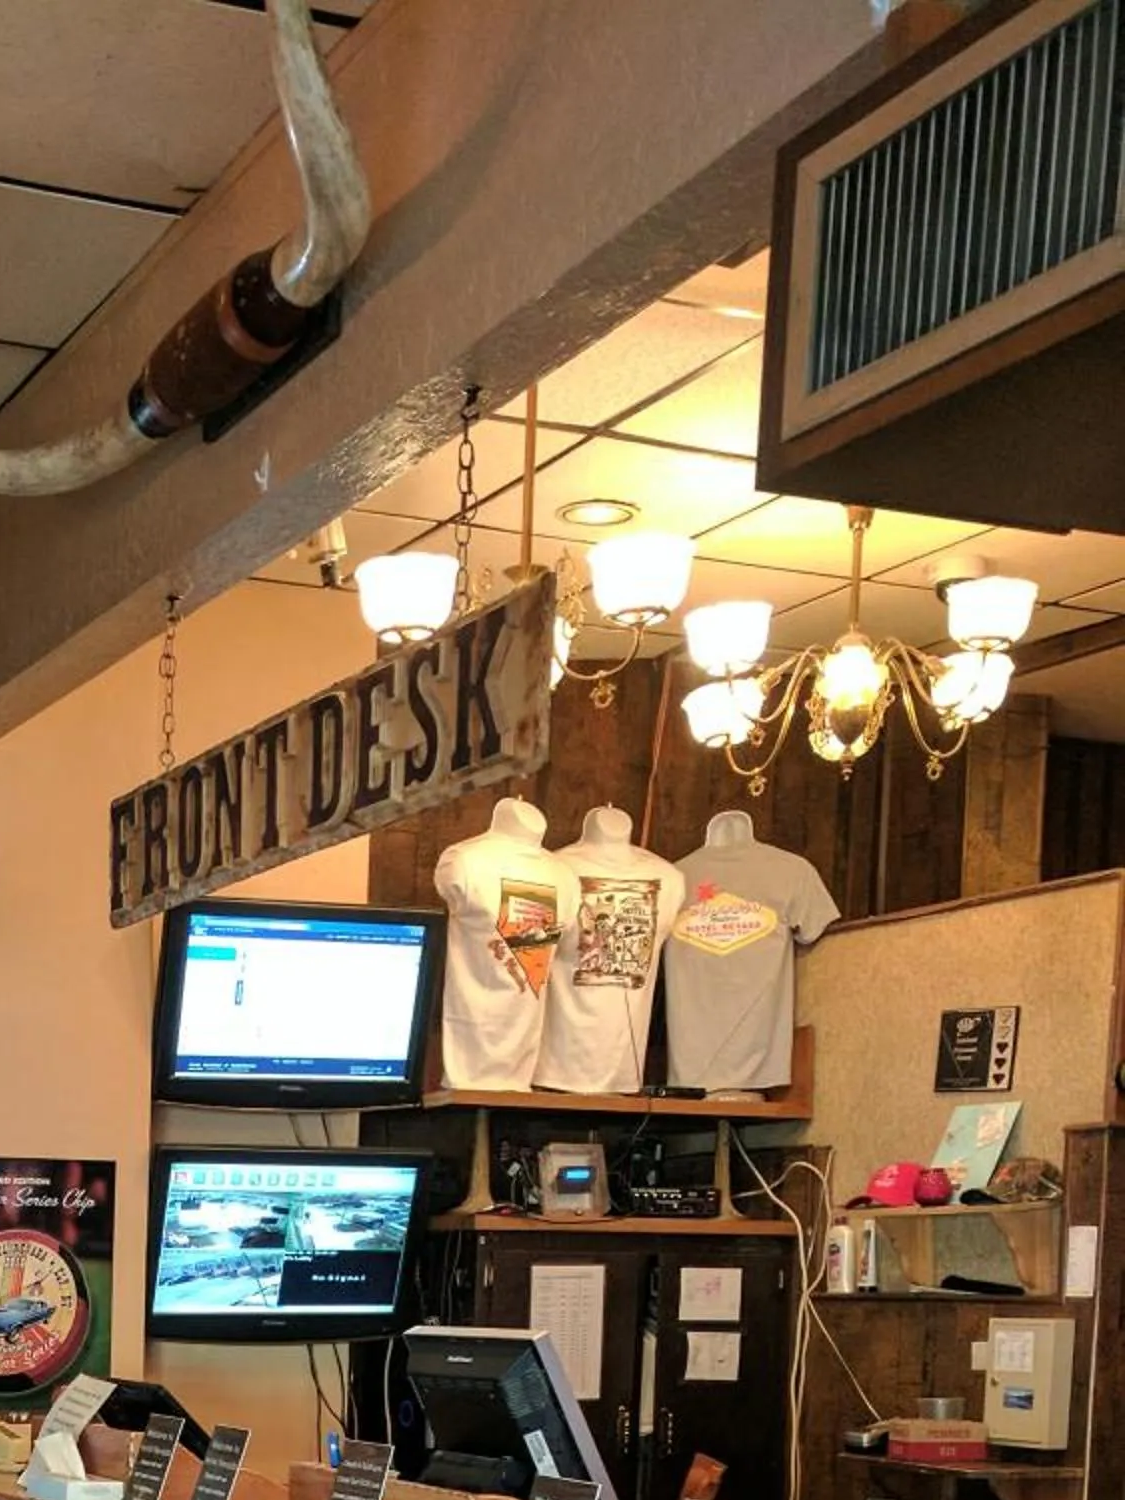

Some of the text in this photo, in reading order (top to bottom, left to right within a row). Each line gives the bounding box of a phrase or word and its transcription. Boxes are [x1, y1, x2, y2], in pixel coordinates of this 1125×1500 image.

[111, 606, 509, 910] FRONT DESK
[11, 1186, 59, 1208] Series
[62, 1188, 97, 1217] Chip
